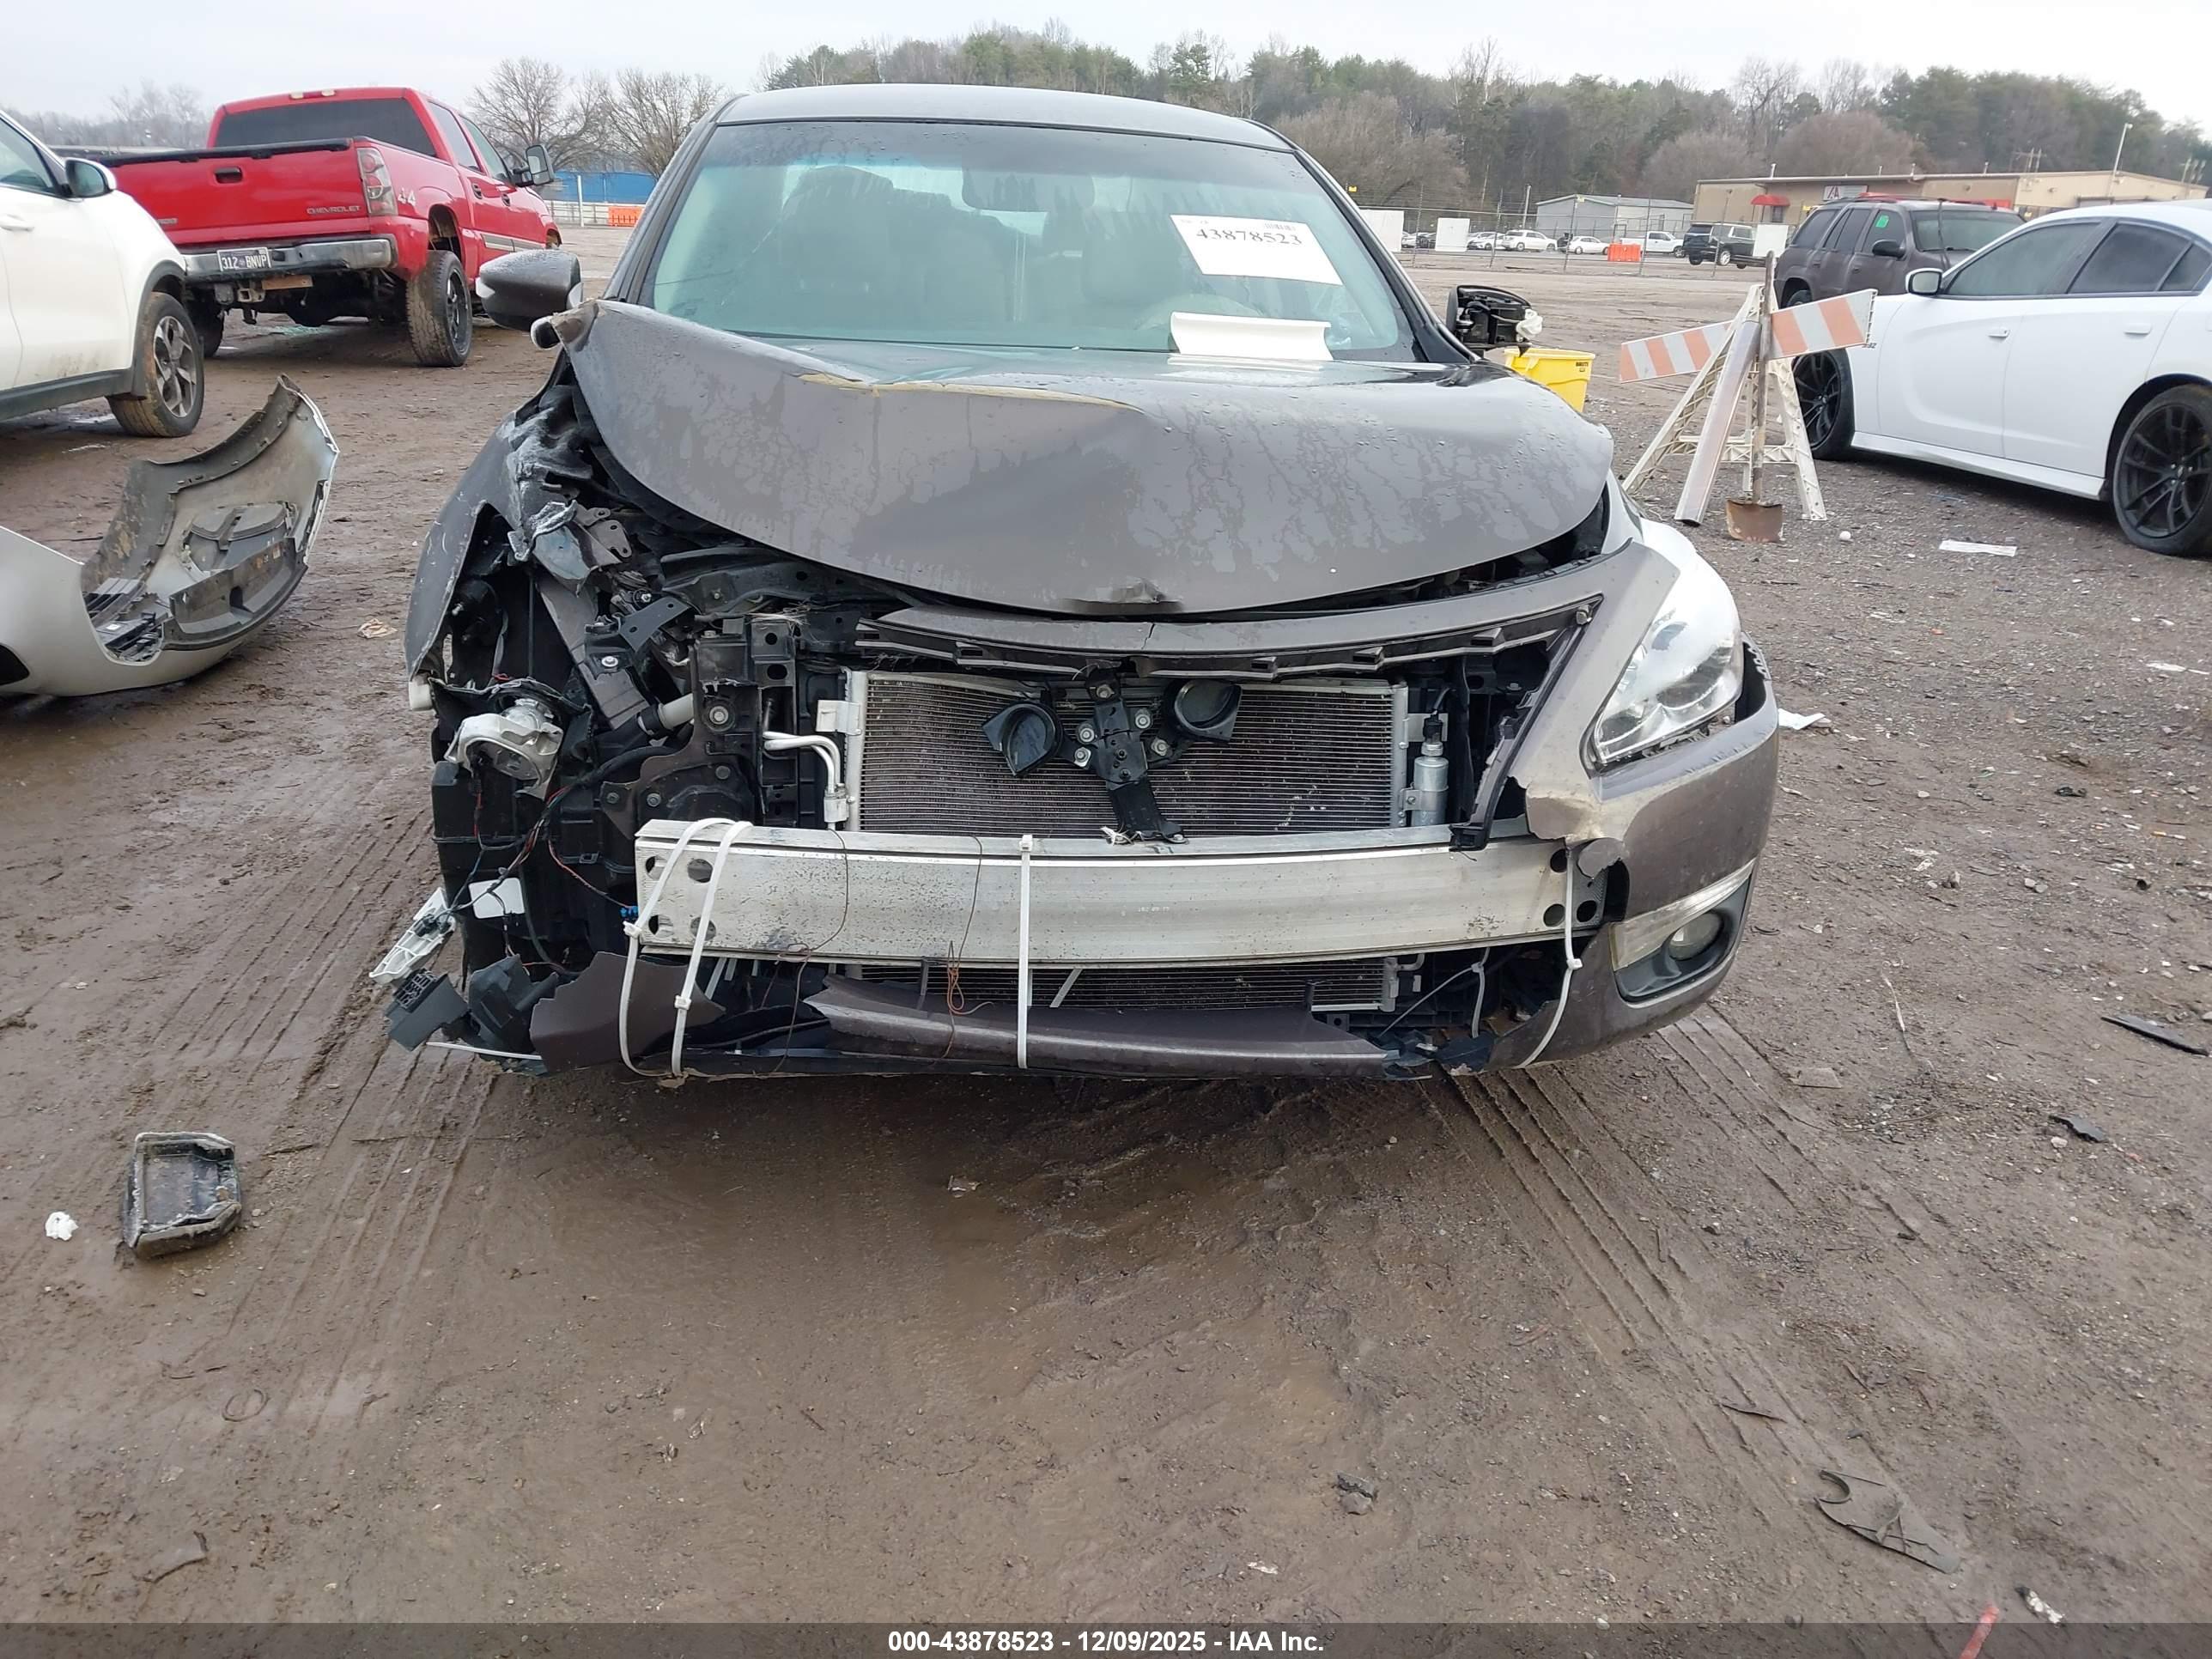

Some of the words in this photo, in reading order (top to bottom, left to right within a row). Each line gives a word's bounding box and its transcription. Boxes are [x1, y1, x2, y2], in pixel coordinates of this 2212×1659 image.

[307, 206, 360, 215] CHEVROLET
[1196, 228, 1303, 246] 43878523
[222, 256, 240, 270] 312
